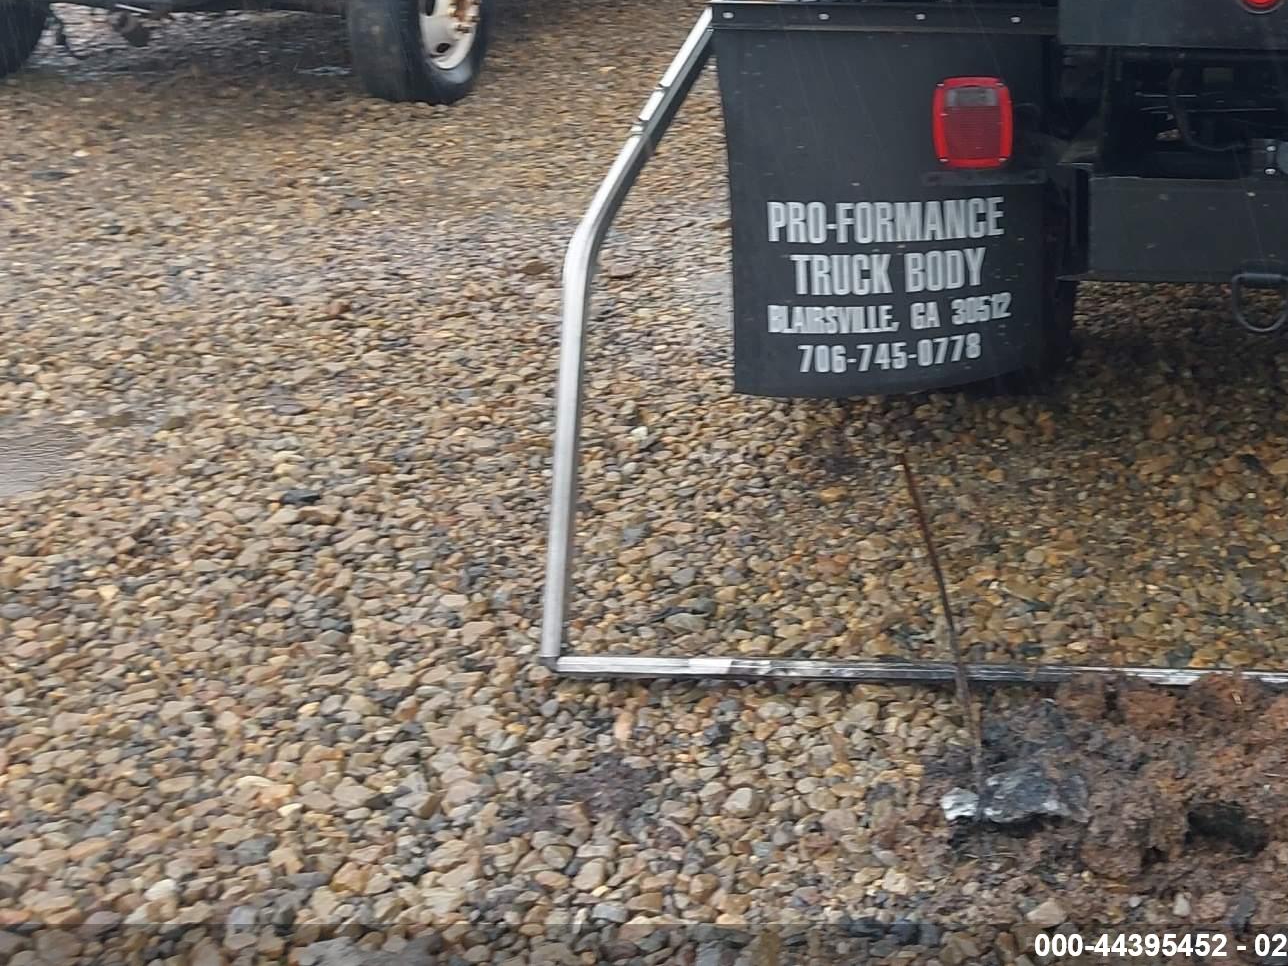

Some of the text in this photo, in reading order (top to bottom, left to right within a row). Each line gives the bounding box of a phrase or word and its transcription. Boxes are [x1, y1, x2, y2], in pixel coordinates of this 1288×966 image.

[767, 196, 1005, 244] PRO-FORMANCE
[789, 247, 986, 296] TRUCK BODY
[910, 301, 941, 330] GA
[951, 292, 1012, 325] 30512
[798, 332, 982, 373] 706-745-0778
